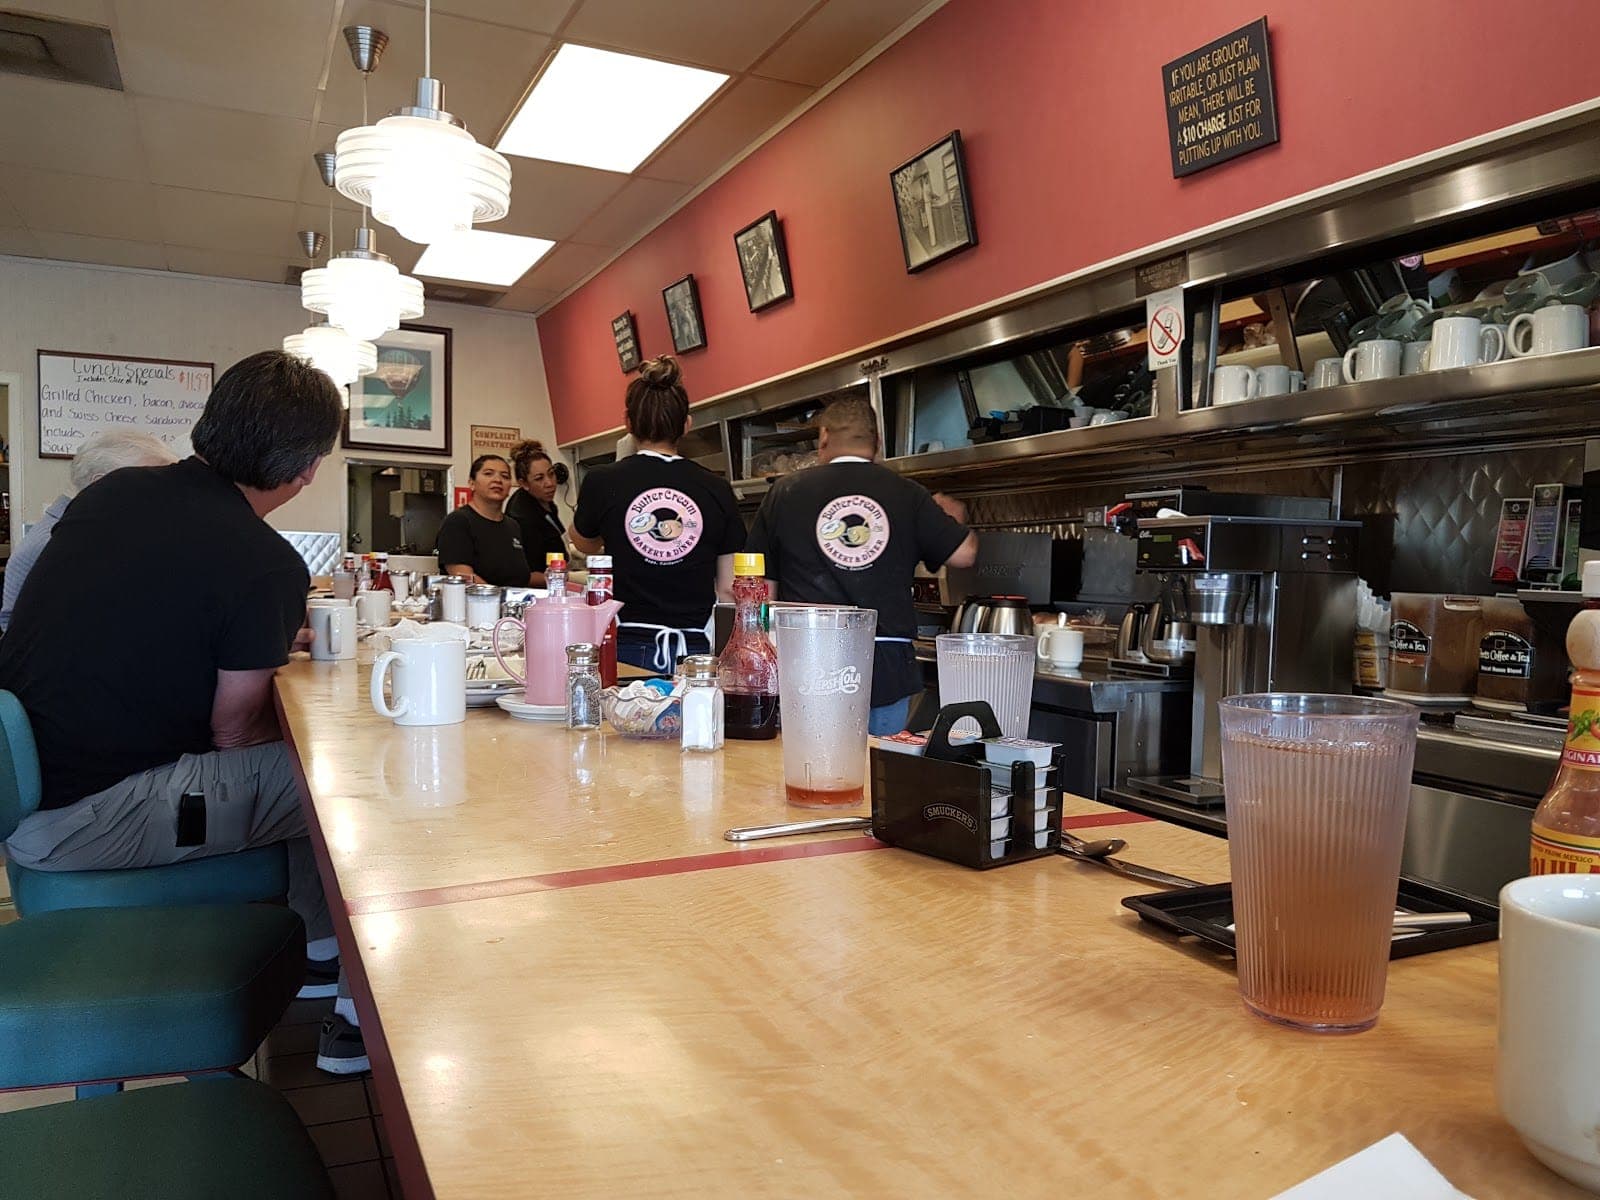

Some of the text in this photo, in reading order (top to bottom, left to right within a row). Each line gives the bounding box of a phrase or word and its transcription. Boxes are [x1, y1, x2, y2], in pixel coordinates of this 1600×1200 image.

[1172, 36, 1253, 87] IF YOU ARE GROUCHY,
[1169, 53, 1260, 107] IRRITABLE, OR JUST PLAIN
[1178, 78, 1255, 125] MEAN, THERE WILL BE
[1177, 98, 1262, 147] A $10 CHARGE JUST FOR
[1179, 121, 1263, 167] PUTTING UP WITH YOU.
[73, 358, 175, 382] Lunch Specials
[179, 371, 209, 392] $11.99
[41, 384, 207, 410] Grilled Chicken, bacon, avoca
[41, 406, 62, 419] and
[474, 440, 513, 449] DEPARTMEN
[475, 431, 516, 441] COMPLAINT
[633, 535, 696, 558] BAKERY & DINER
[824, 542, 853, 563] BAKERY
[862, 540, 885, 561] DINER
[1490, 650, 1510, 662] Coffee
[1516, 651, 1530, 662] Tea
[926, 805, 974, 828] SMUCKER'S
